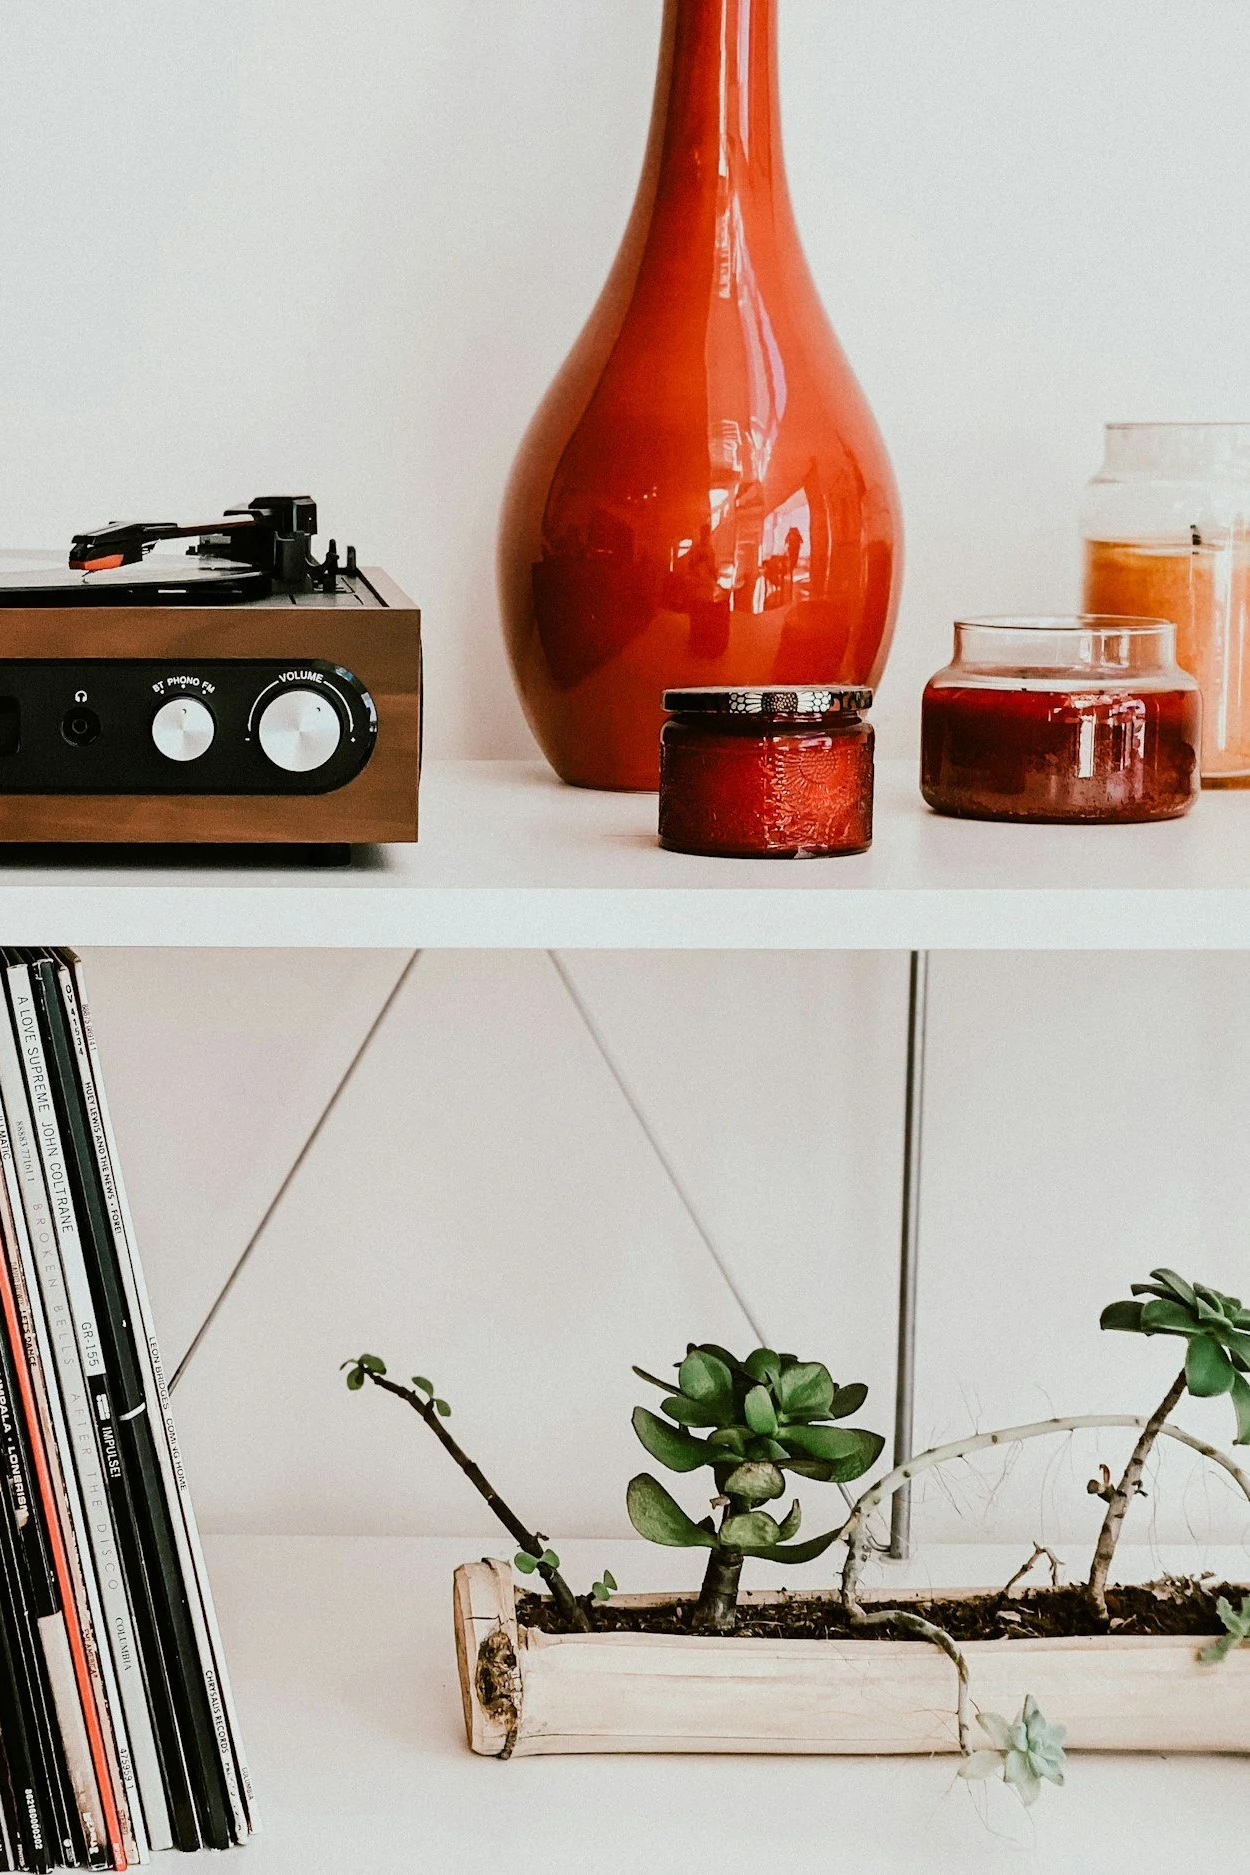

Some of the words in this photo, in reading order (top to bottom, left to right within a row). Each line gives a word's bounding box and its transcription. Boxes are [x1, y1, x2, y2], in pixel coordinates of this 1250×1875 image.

[152, 681, 165, 693] BT
[166, 675, 200, 687] PHONO
[201, 681, 216, 694] FM
[278, 670, 324, 684] VOLUME
[16, 996, 30, 1005] A
[19, 1009, 38, 1043] LOVE
[26, 1047, 52, 1112] SUPREME
[83, 1081, 96, 1106] HUEY
[15, 1120, 29, 1147] 88883
[89, 1107, 102, 1133] LEWIS
[41, 1121, 60, 1157] JOHN
[94, 1134, 106, 1154] AND
[21, 1148, 35, 1174] 77161
[99, 1155, 110, 1172] THE
[49, 1162, 75, 1233] COLTRANE
[103, 1174, 115, 1199] NEWS
[111, 1209, 122, 1234] FORE!
[25, 1335, 38, 1368] DANCE
[80, 1321, 100, 1367] GR-155
[149, 1336, 162, 1363] LEON
[32, 1203, 60, 1289] BROKEN
[53, 1304, 76, 1366] BELLS
[70, 1393, 93, 1456] AFTER
[86, 1472, 103, 1507] THE
[96, 1524, 120, 1590] DISCO
[155, 1365, 172, 1410] BRIDGES
[101, 1426, 123, 1477] IMPULSE!
[7, 1446, 30, 1516] LONERISM
[175, 1461, 188, 1491] HOME
[114, 1617, 134, 1672] COLUMBIA
[205, 1670, 222, 1714] CHRYSALIS
[214, 1716, 231, 1754] RECORDS
[119, 1748, 134, 1782] 475959
